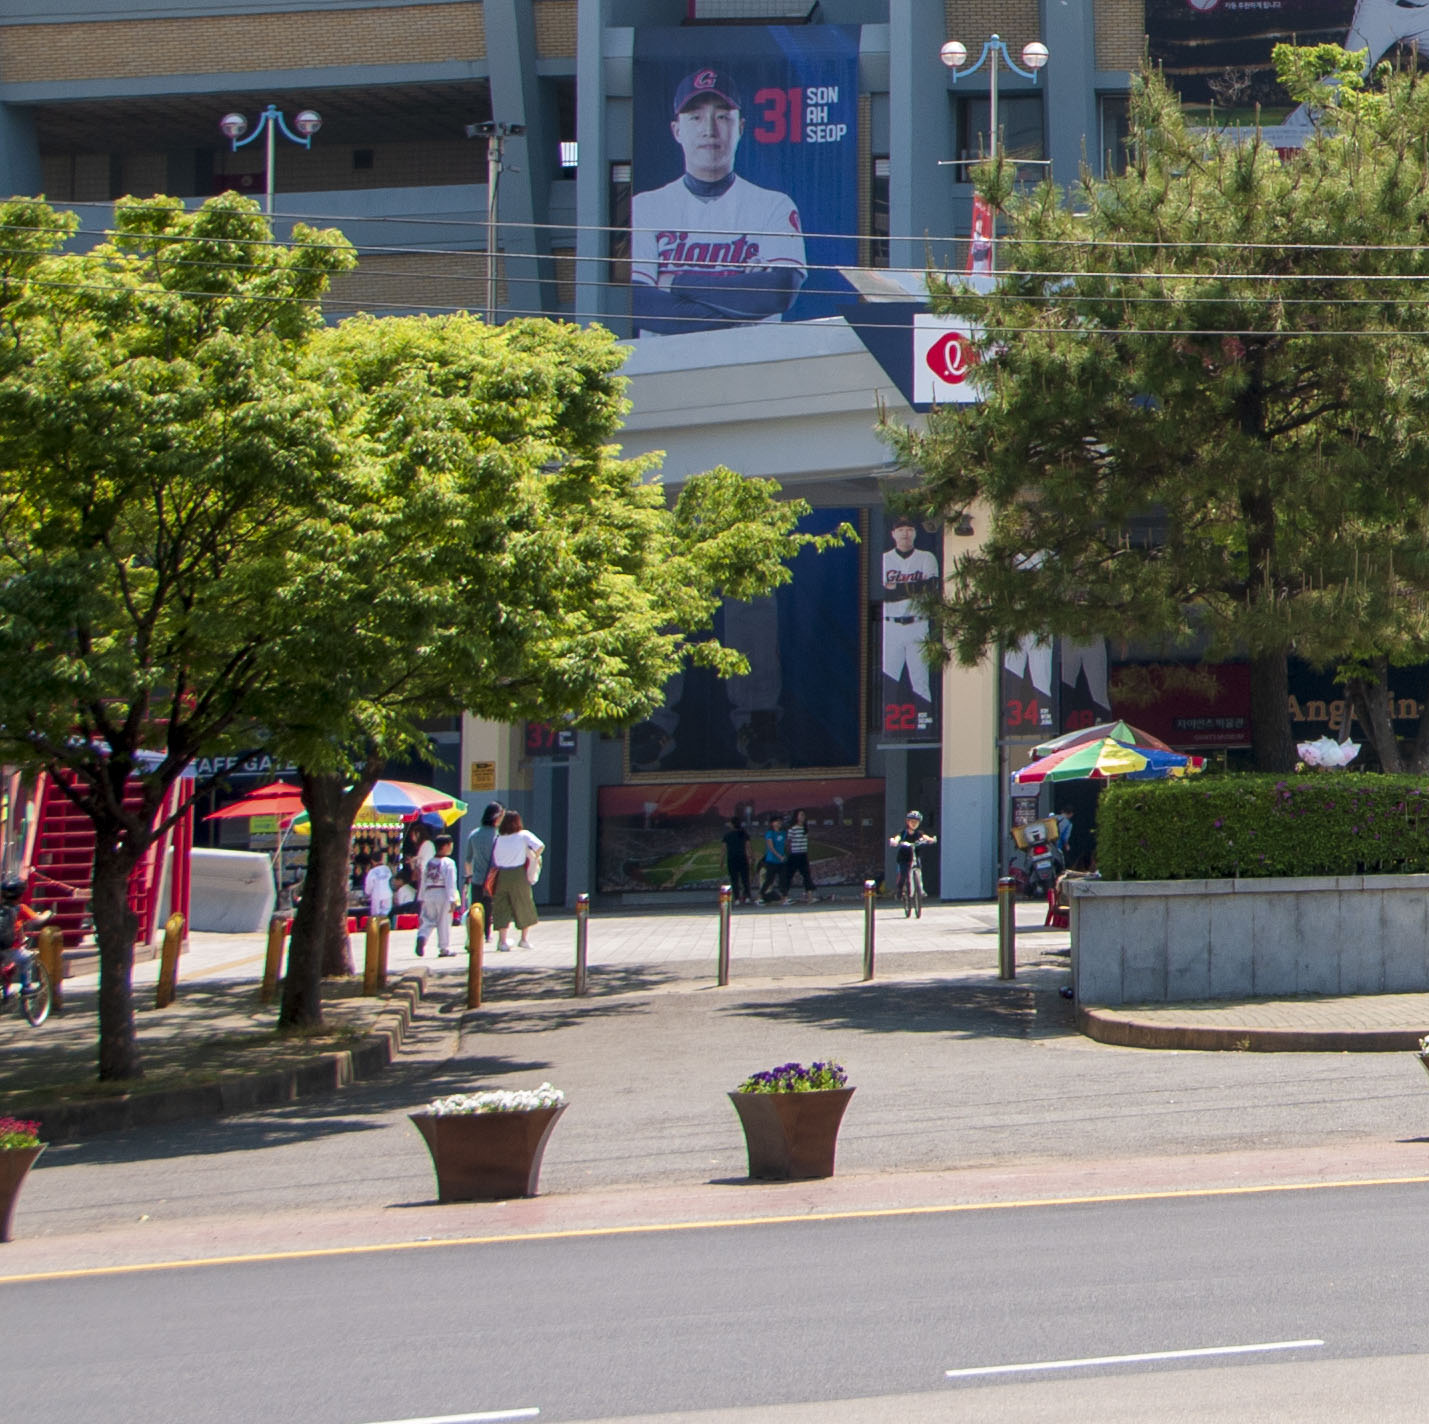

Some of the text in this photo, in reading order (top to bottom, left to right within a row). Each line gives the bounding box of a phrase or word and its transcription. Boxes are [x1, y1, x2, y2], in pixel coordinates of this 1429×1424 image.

[806, 87, 839, 104] SON
[753, 87, 803, 144] 31
[806, 106, 829, 124] AH
[806, 125, 847, 143] SEOP
[885, 704, 915, 730] 22
[1007, 700, 1038, 725] 34
